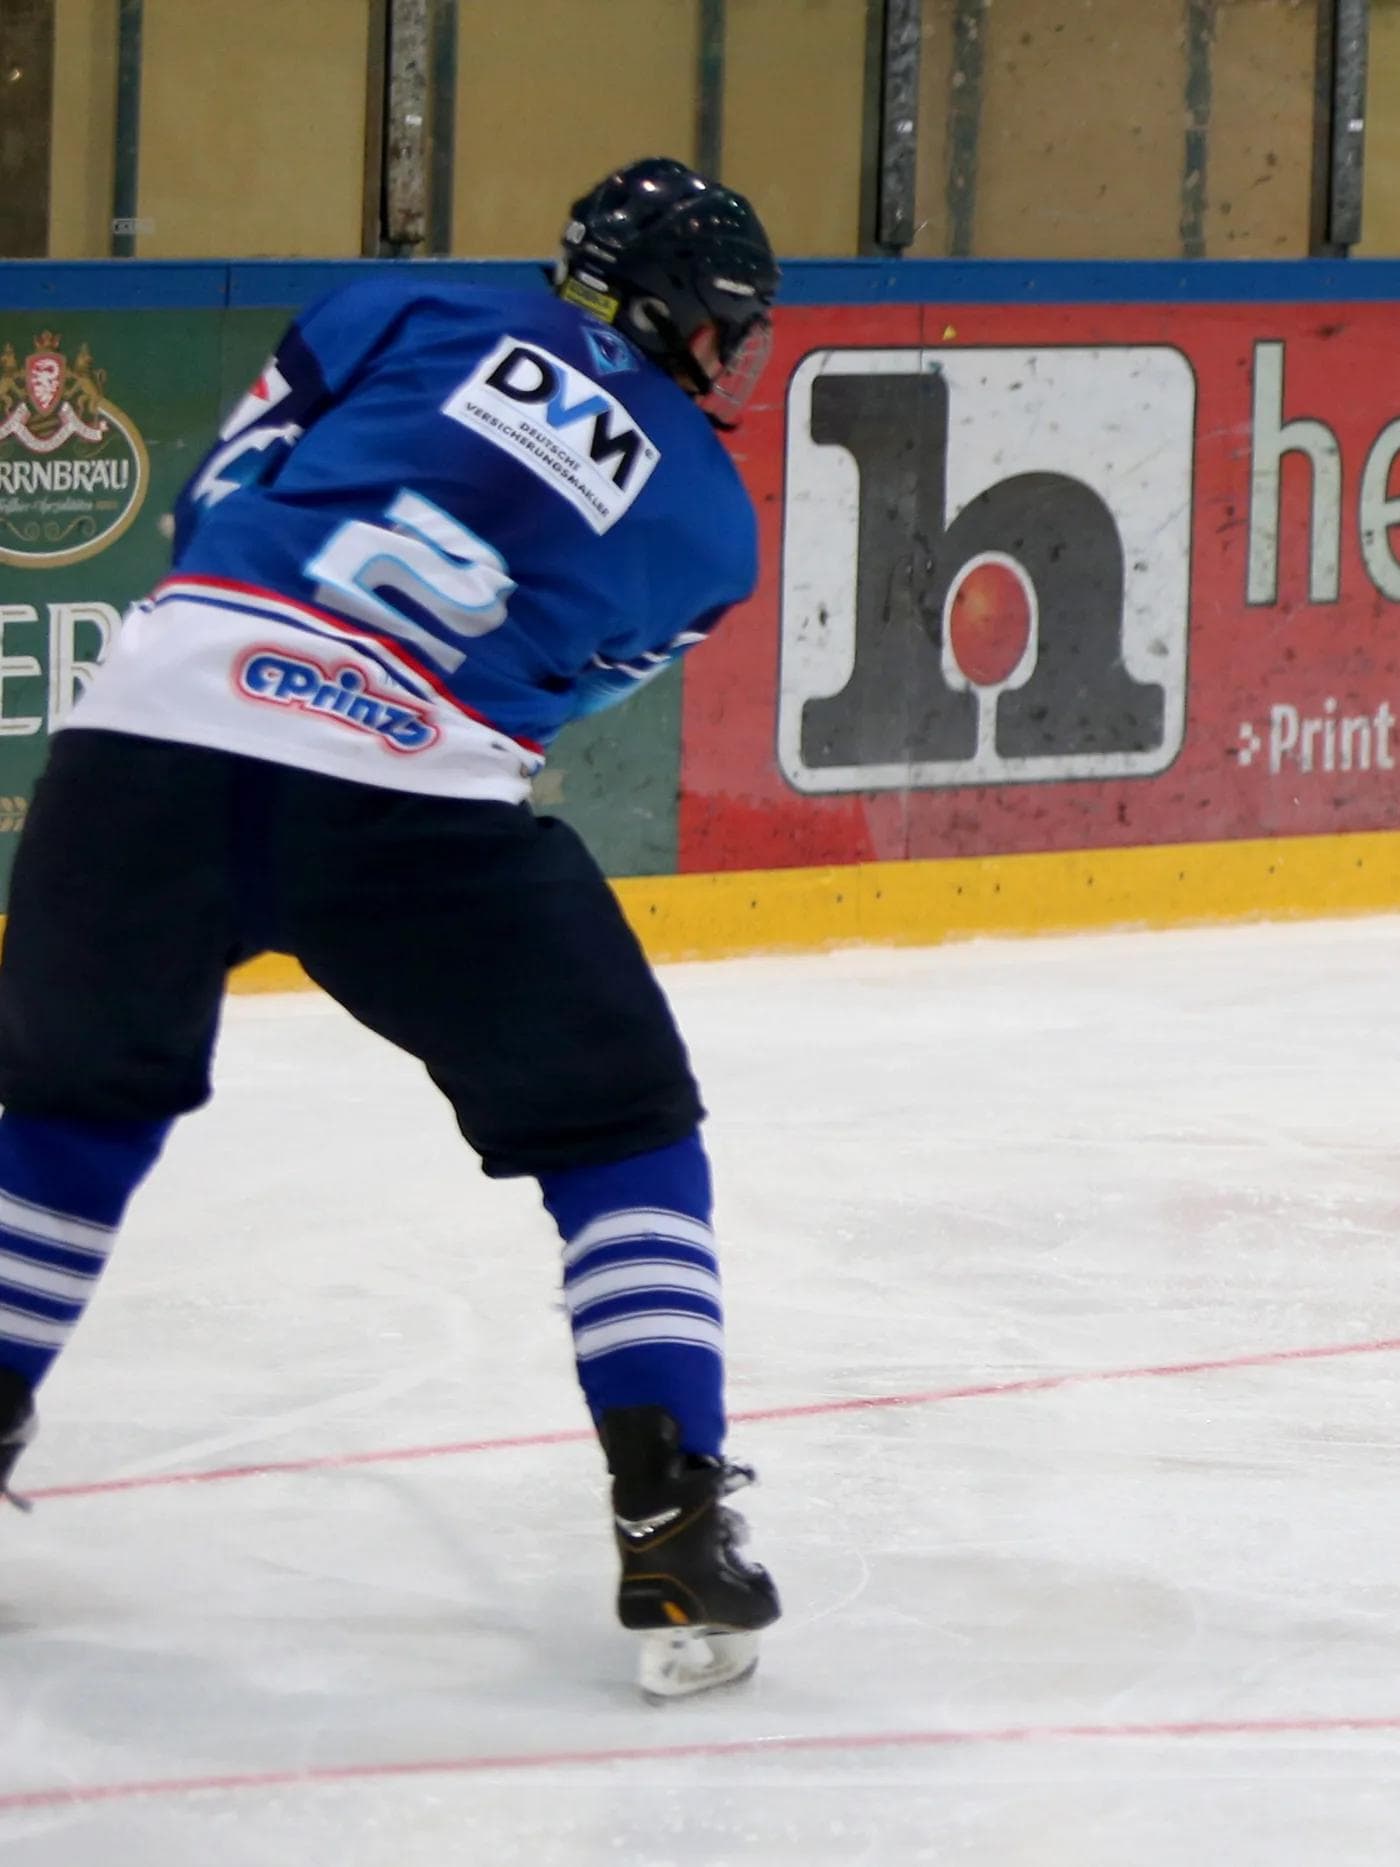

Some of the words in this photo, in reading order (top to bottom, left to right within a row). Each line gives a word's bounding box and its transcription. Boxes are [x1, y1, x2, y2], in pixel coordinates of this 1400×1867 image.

[465, 401, 612, 519] VERSICHERUNGSMAKLER
[485, 347, 643, 493] DVM
[519, 421, 581, 472] DEUTSCHE
[1270, 697, 1397, 774] Print
